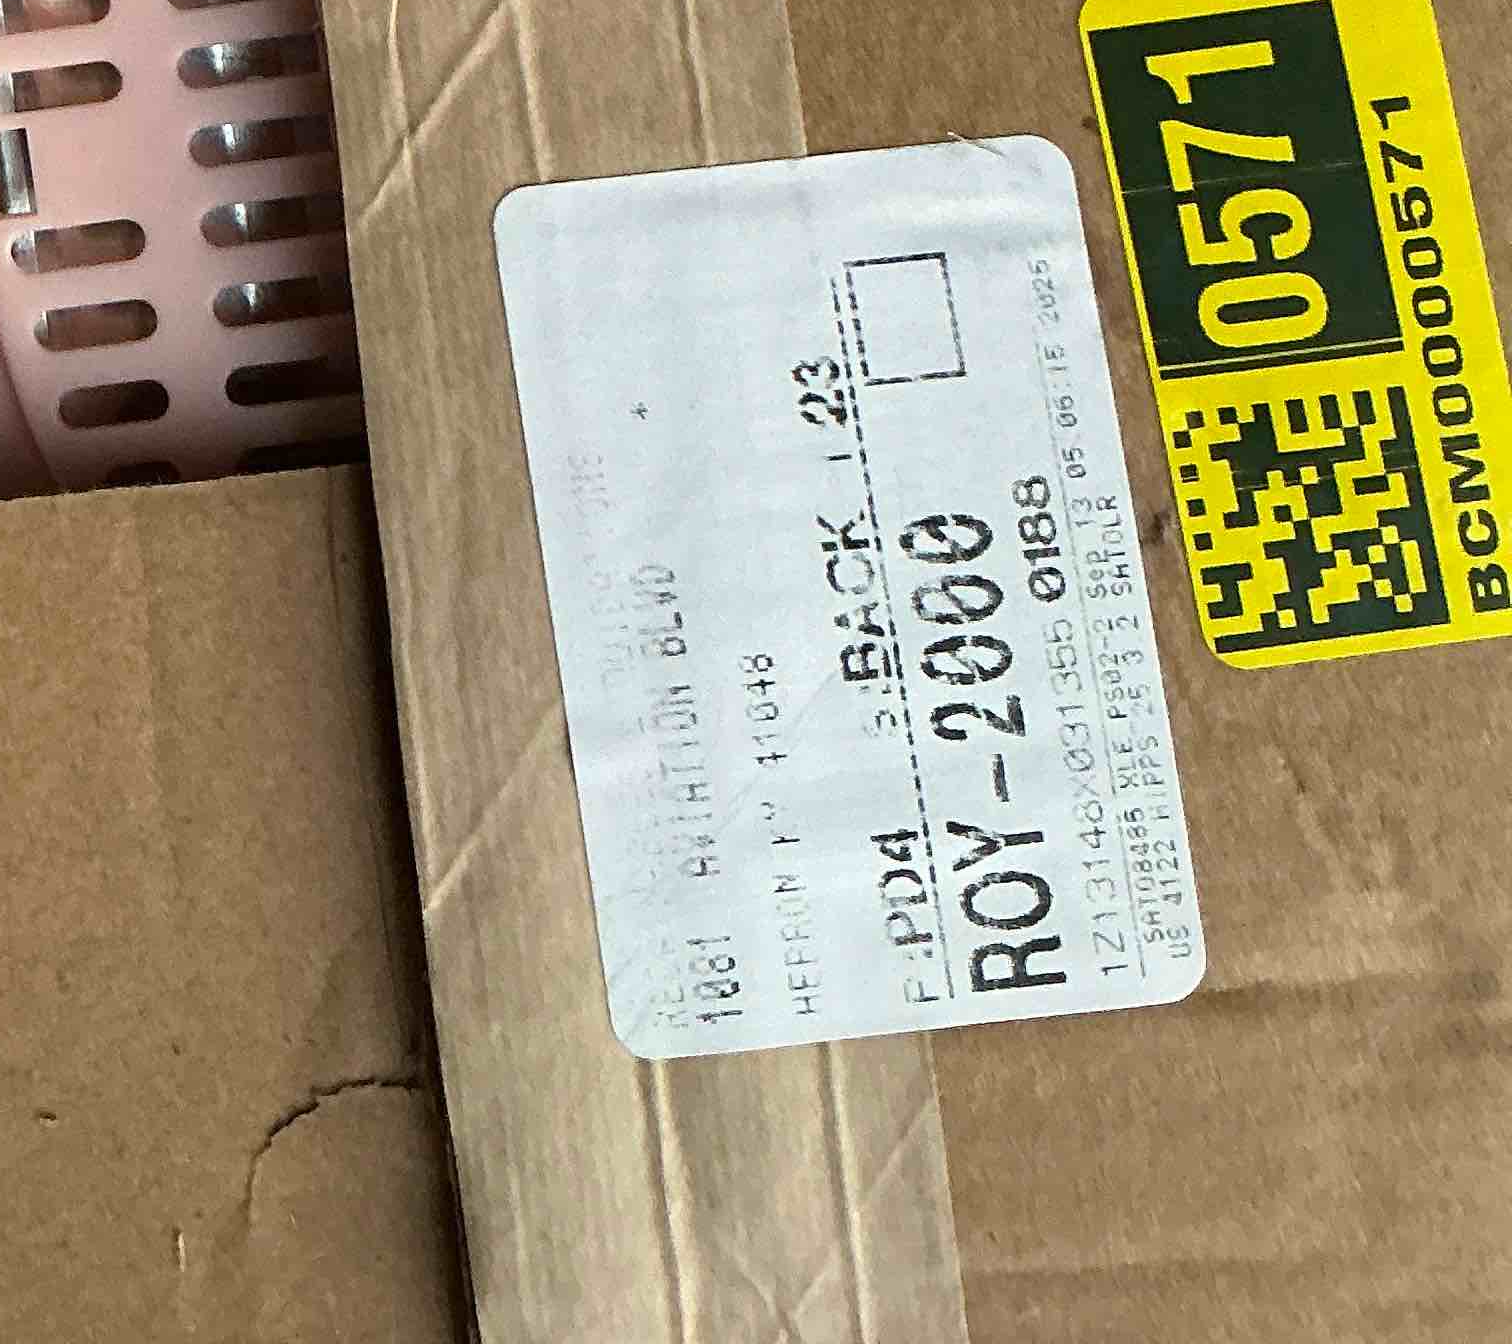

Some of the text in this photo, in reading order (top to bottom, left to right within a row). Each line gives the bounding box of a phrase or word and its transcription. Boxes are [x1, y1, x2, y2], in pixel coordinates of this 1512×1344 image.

[1145, 40, 1328, 348] 0571
[1370, 96, 1512, 613] BCM0000571
[896, 508, 1066, 996] ROY-2000
[1083, 548, 1107, 599] Sep
